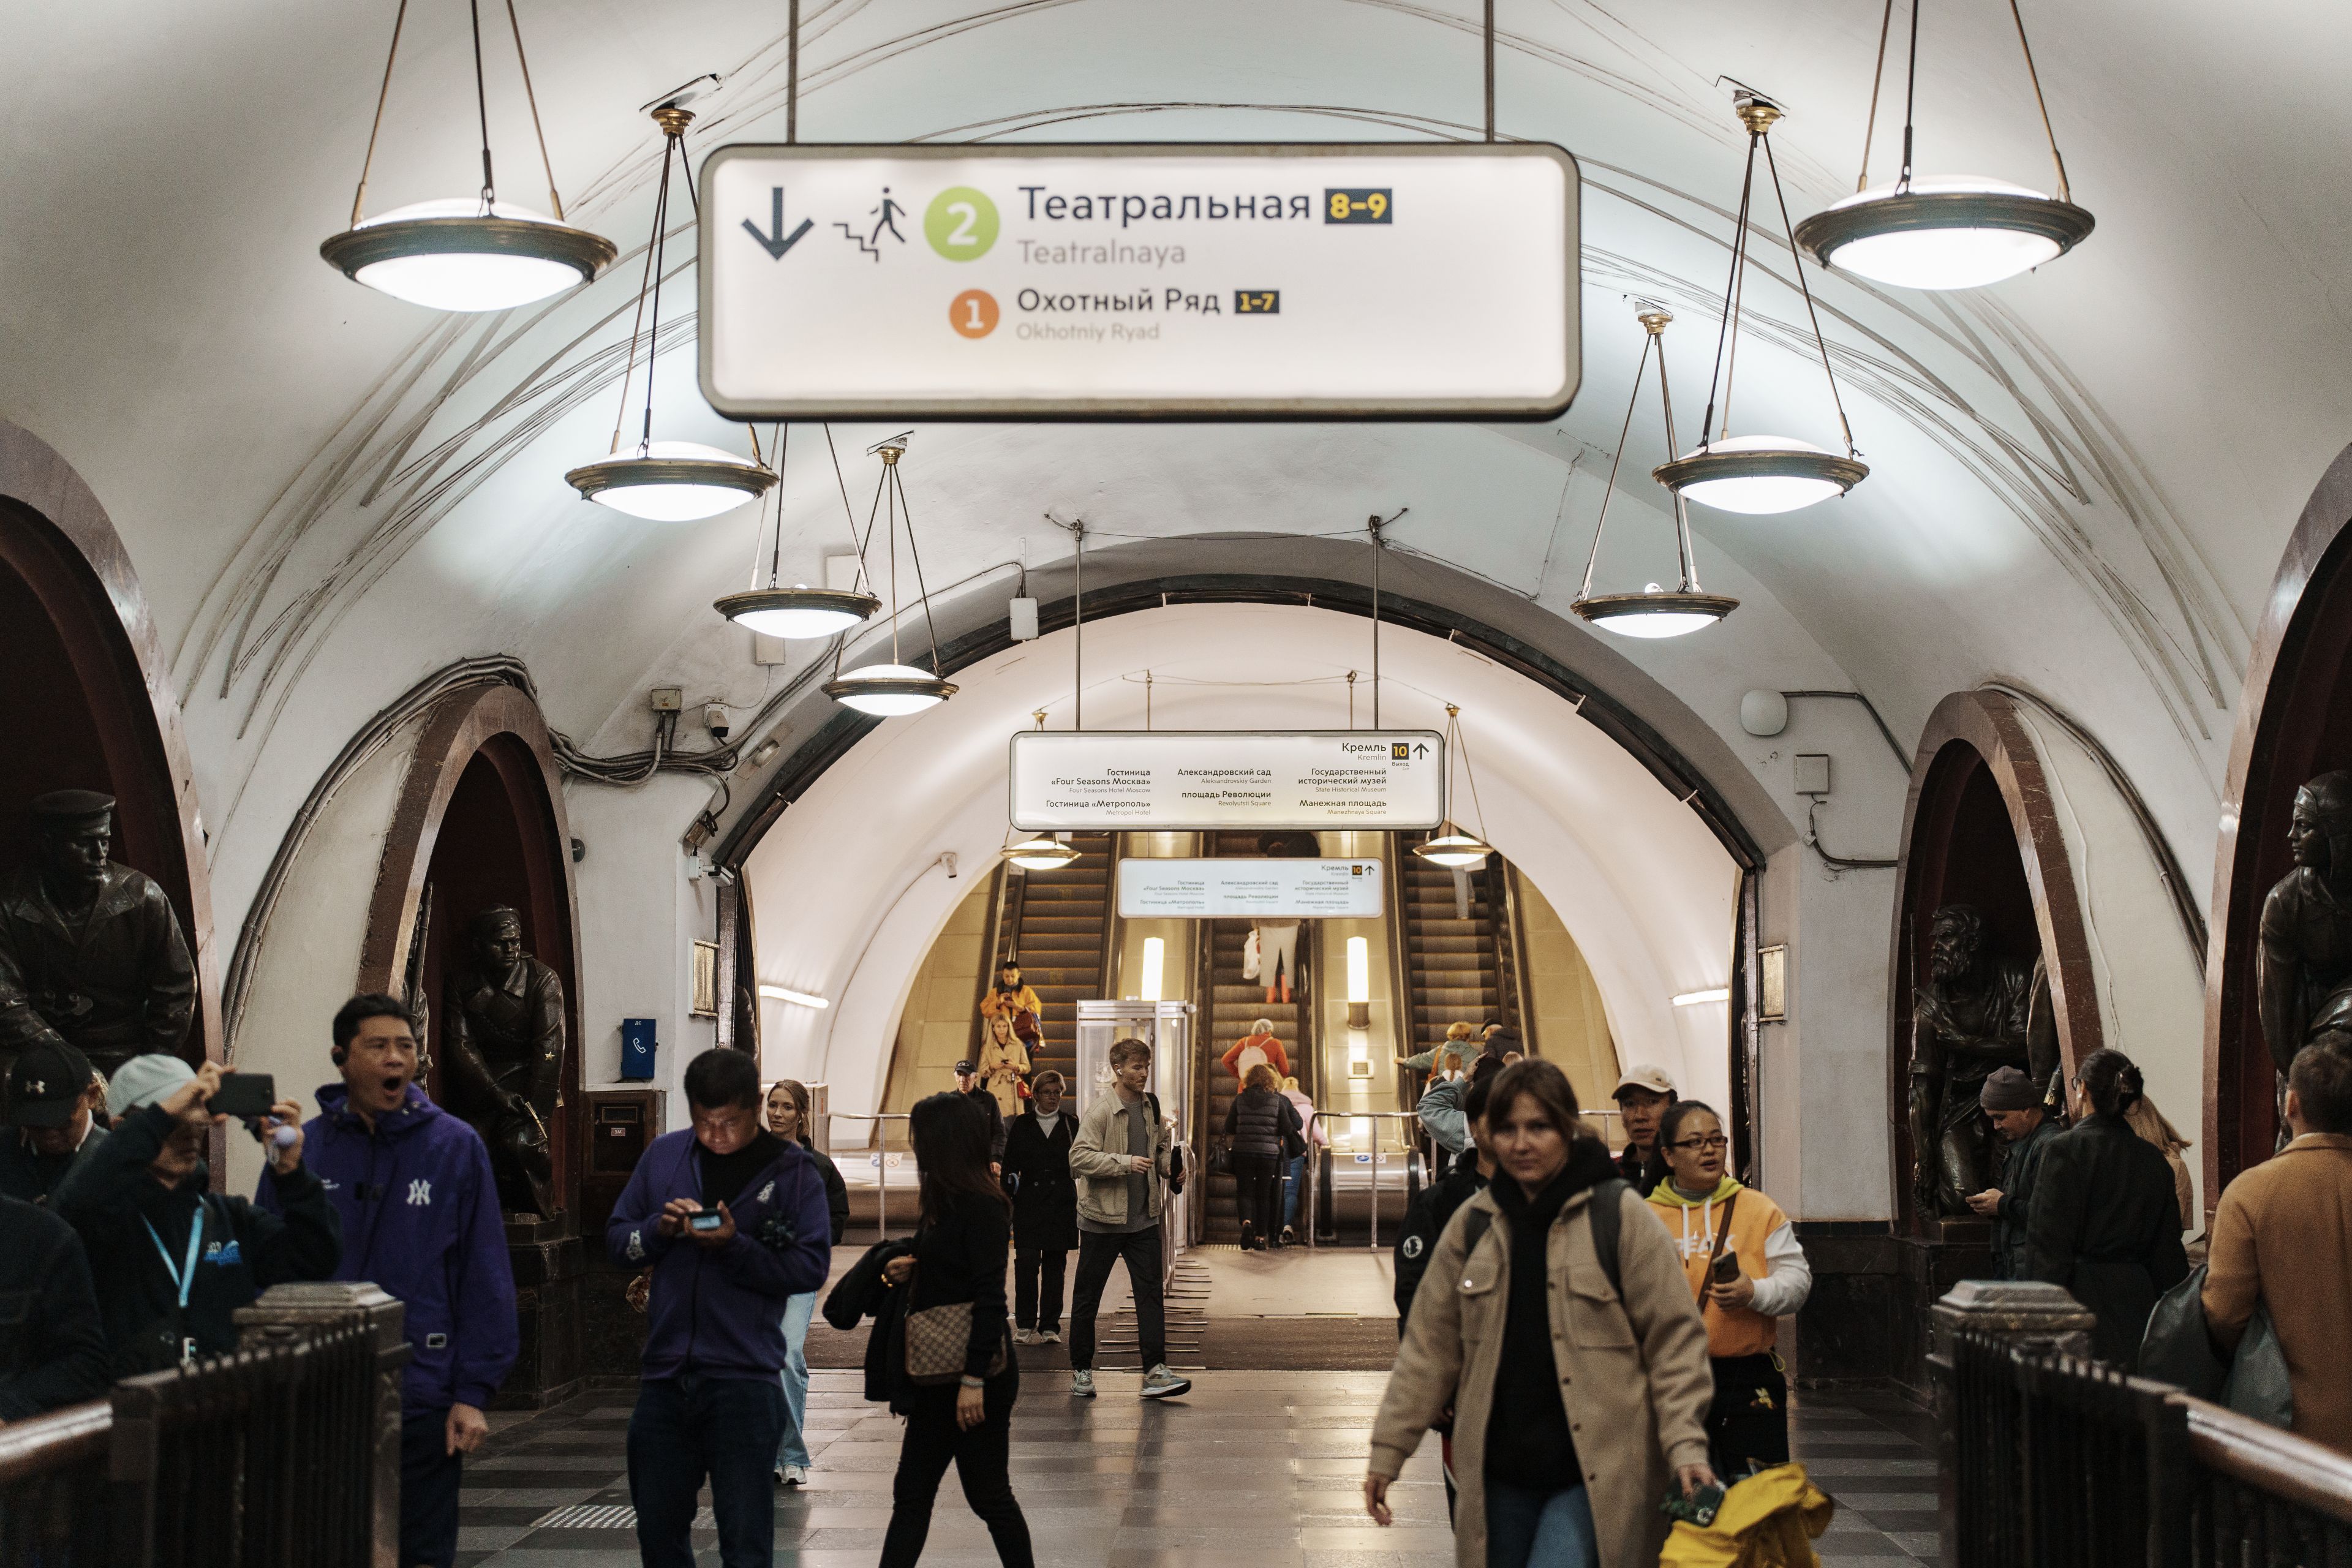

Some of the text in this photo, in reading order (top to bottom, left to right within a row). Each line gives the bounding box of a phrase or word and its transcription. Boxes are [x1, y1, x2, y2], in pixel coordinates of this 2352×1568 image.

[1018, 186, 1310, 228] Театральная
[946, 201, 978, 246] 2
[1016, 238, 1185, 269] Teatralnaya
[965, 298, 985, 330] 1
[1017, 288, 1153, 312] Охотный
[1166, 288, 1221, 315] Ряд
[1016, 322, 1161, 343] Okhotniy Ryad
[1342, 742, 1408, 758] Кремль 10
[1177, 768, 1254, 777] Александровский
[1311, 767, 1386, 777] Государственный
